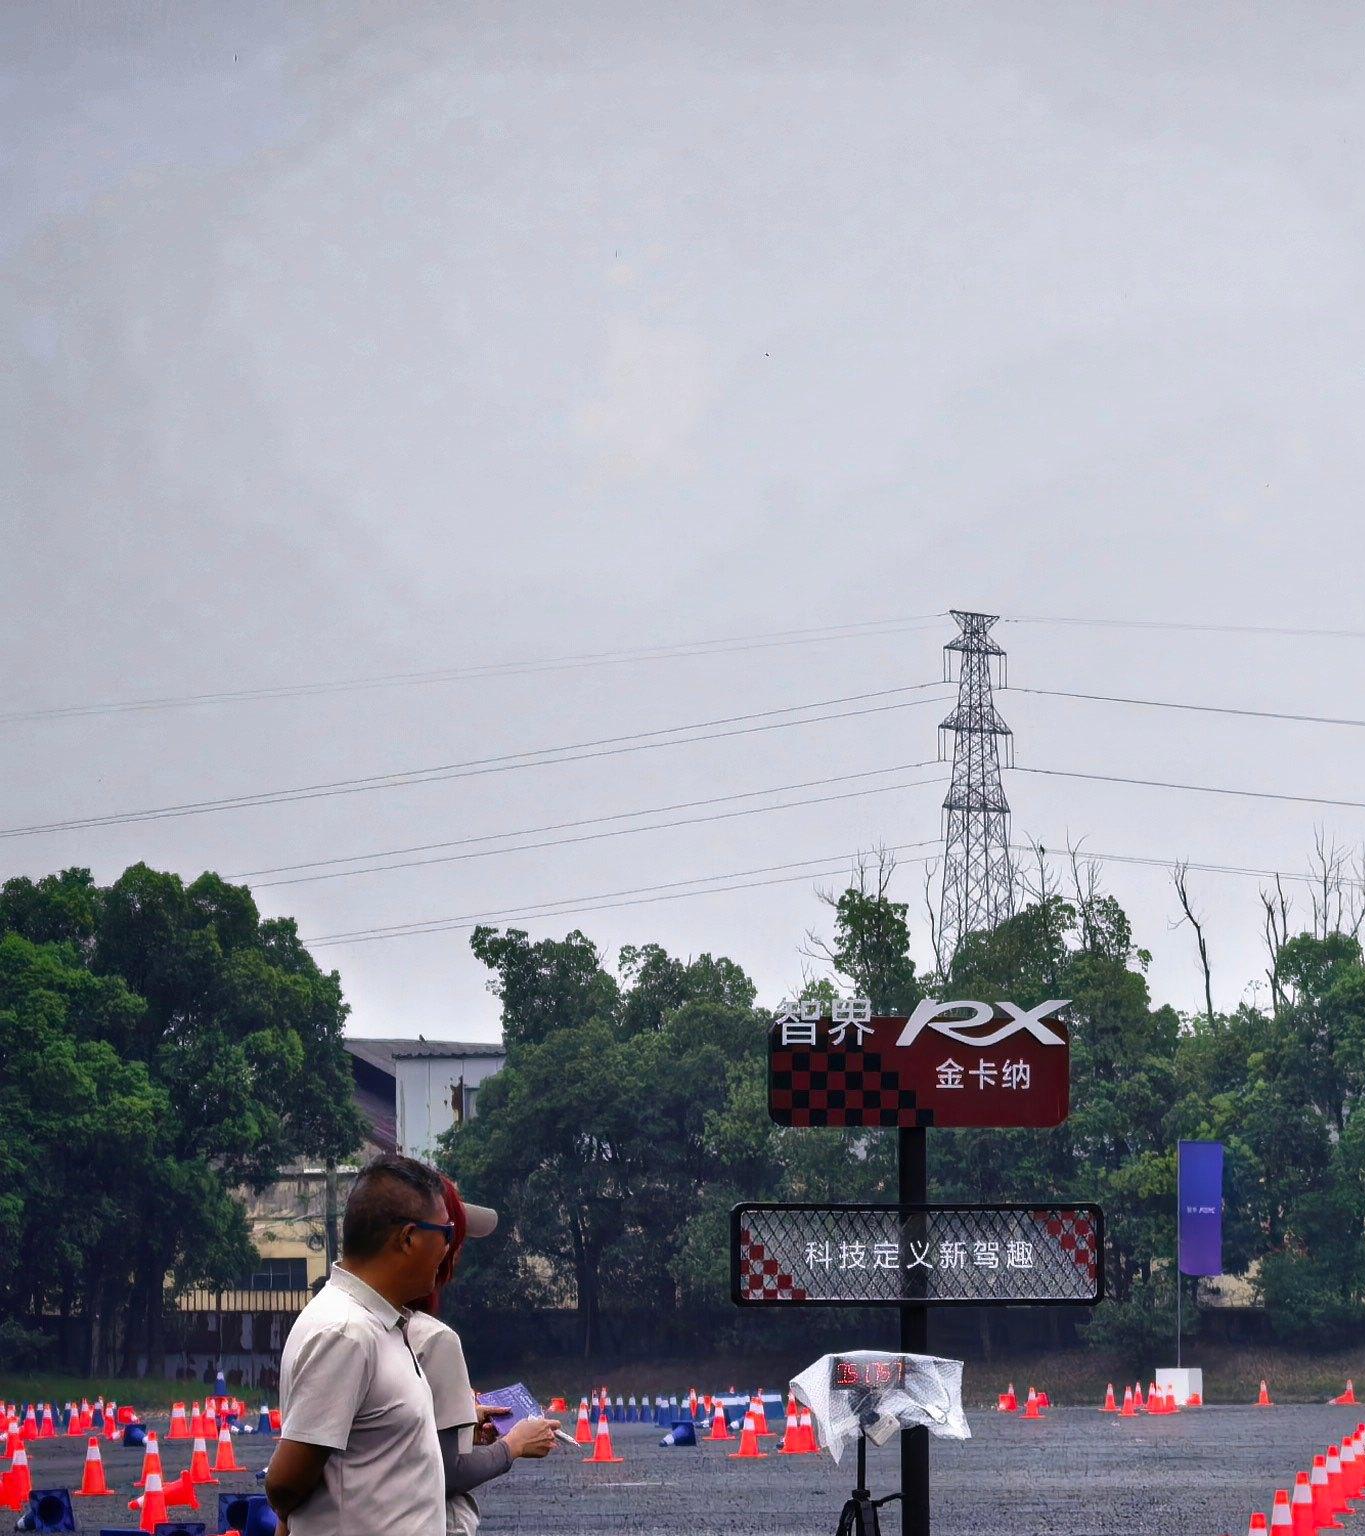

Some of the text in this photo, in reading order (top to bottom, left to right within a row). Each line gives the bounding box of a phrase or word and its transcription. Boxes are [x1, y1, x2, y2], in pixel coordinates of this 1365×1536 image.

[775, 998, 1073, 1047] 智界 RX
[935, 1057, 1031, 1091] 金卡纳
[805, 1239, 1034, 1270] 科技定义新驾趣
